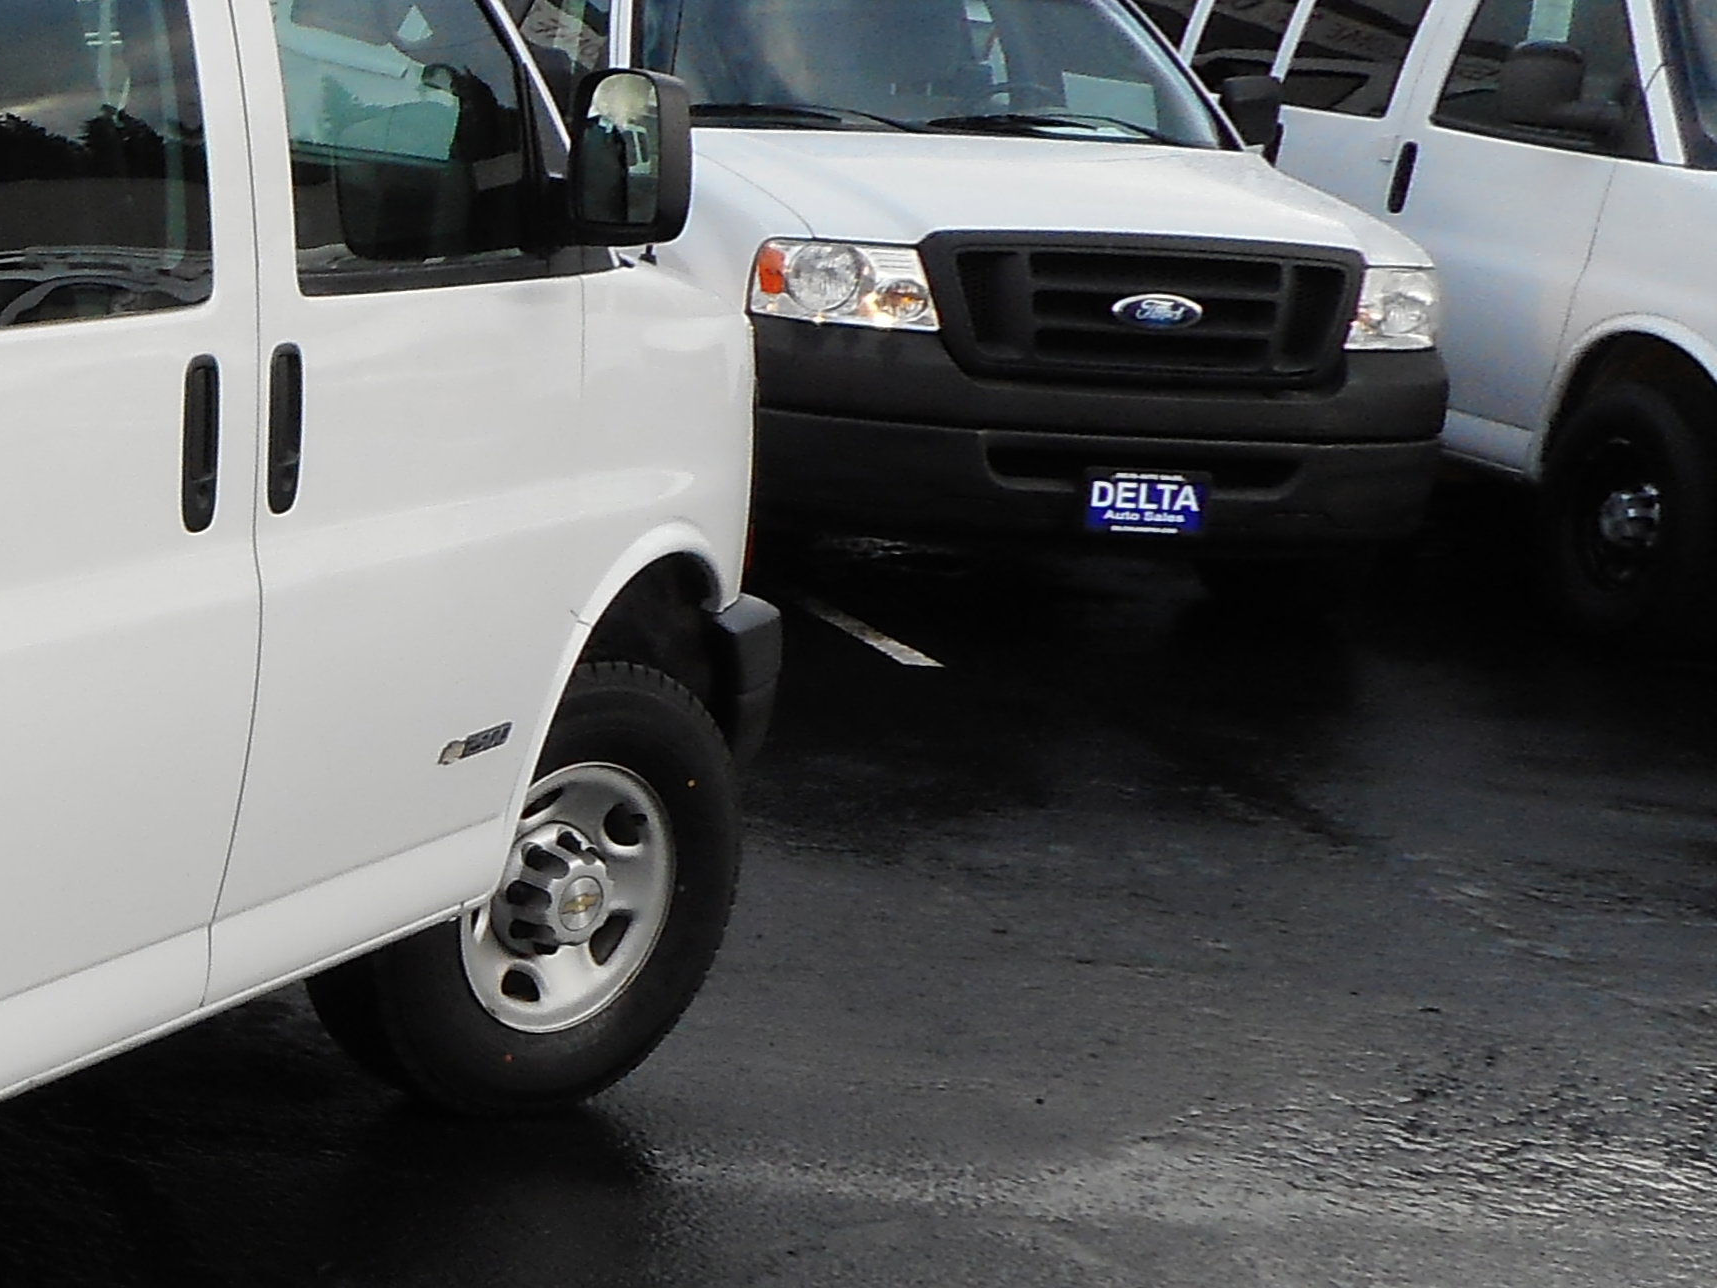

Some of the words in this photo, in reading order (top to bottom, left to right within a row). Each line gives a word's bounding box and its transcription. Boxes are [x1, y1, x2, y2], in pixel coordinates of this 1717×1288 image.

[1090, 480, 1201, 512] DELTA
[1103, 509, 1141, 521] Auto
[1143, 511, 1186, 523] Sales
